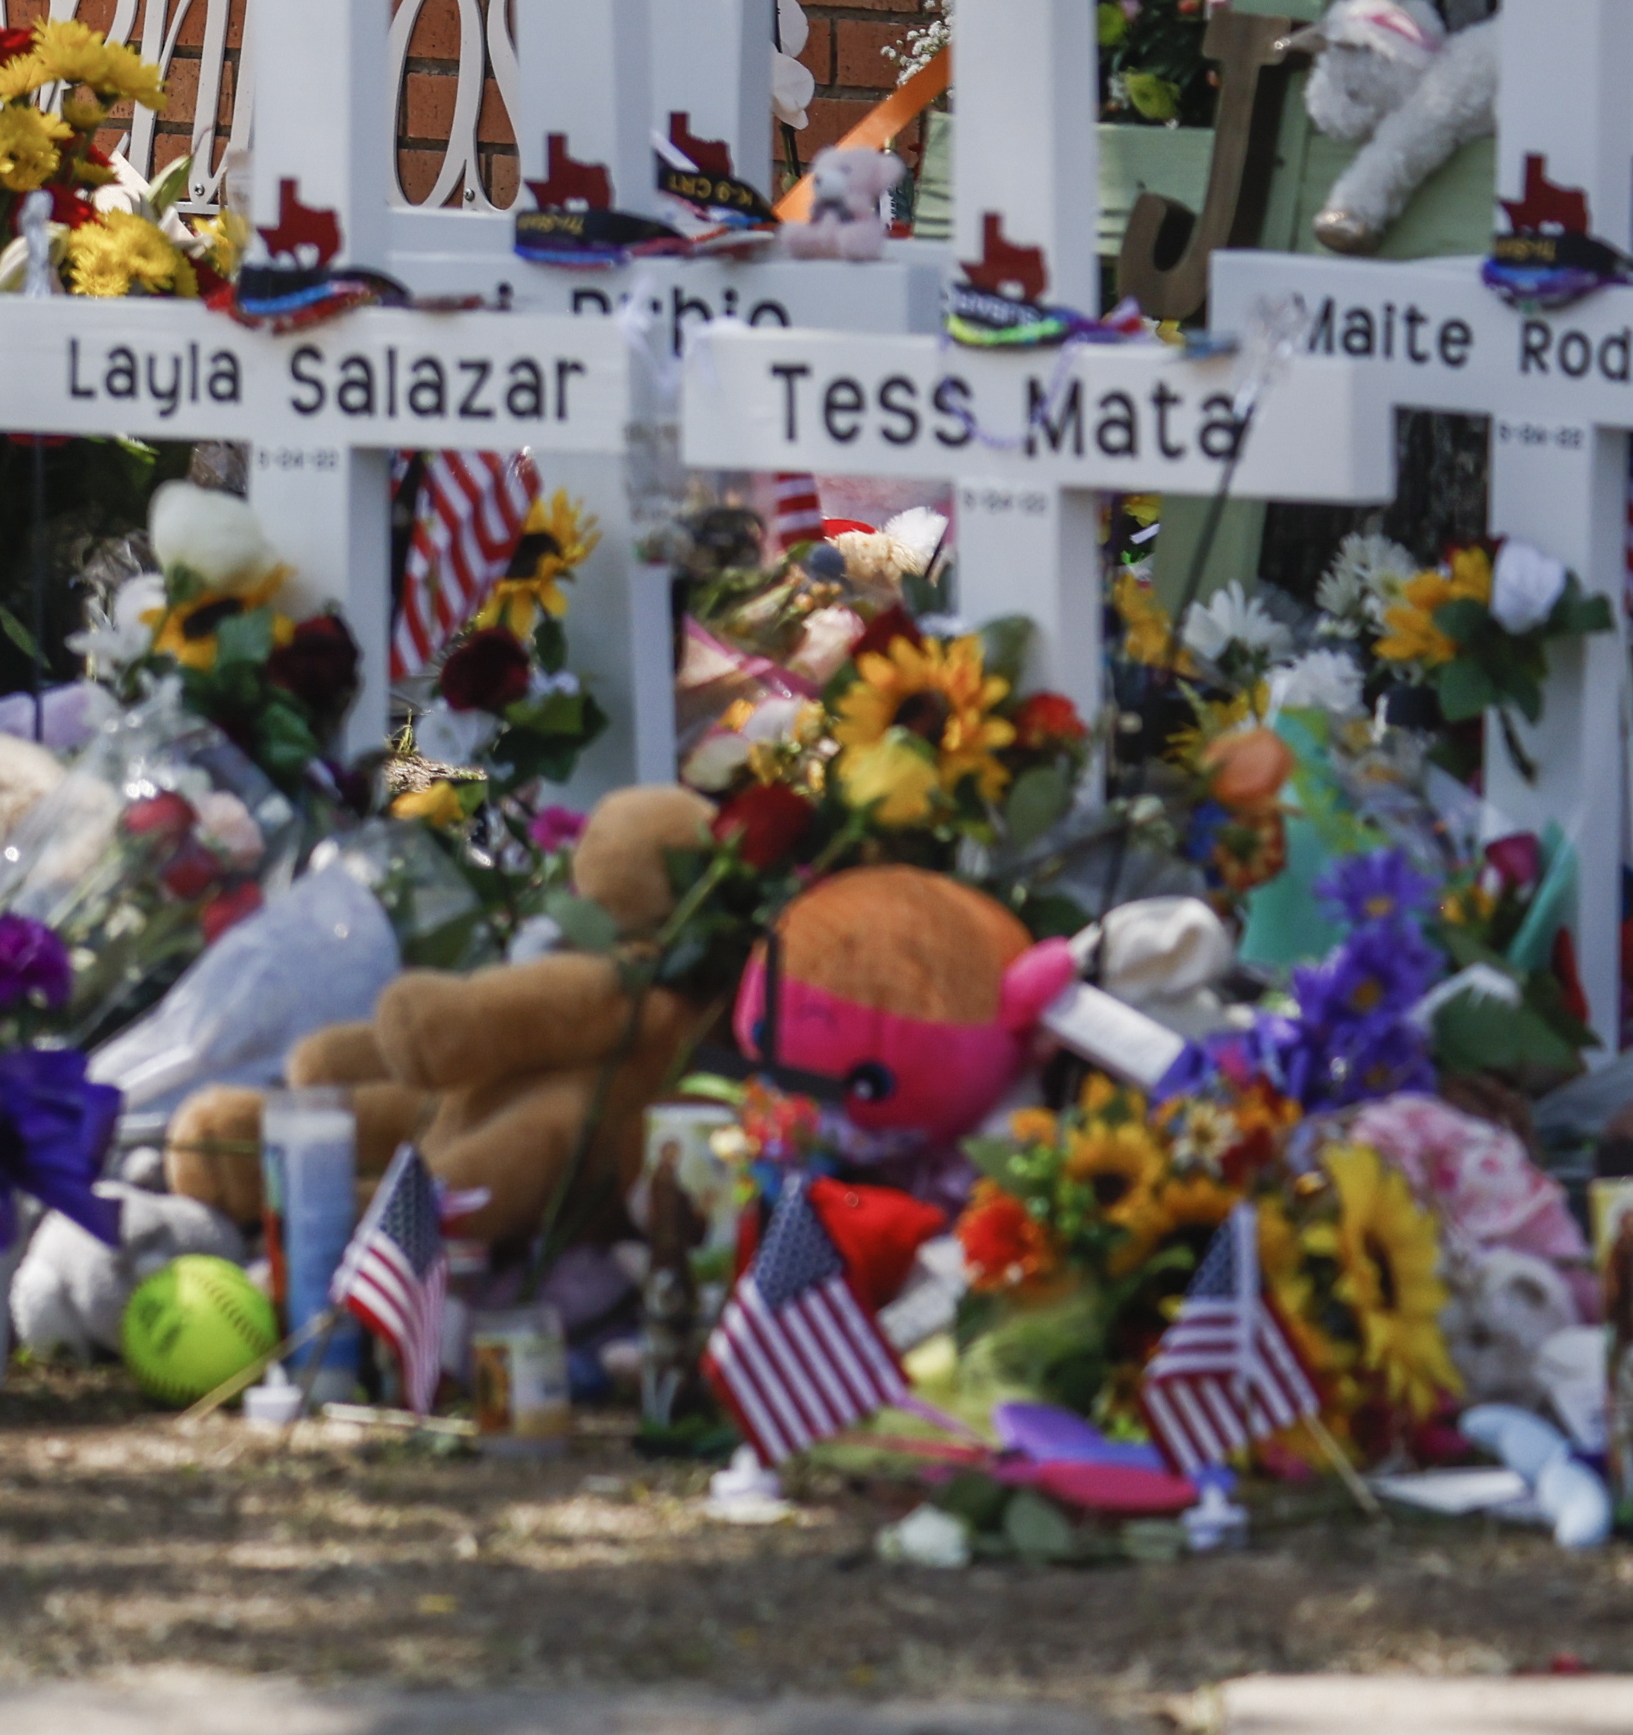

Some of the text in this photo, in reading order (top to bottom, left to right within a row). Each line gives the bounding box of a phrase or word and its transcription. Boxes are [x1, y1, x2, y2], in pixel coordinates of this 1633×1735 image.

[68, 337, 588, 420] Layla Salazar
[771, 363, 1243, 460] Tess Mata
